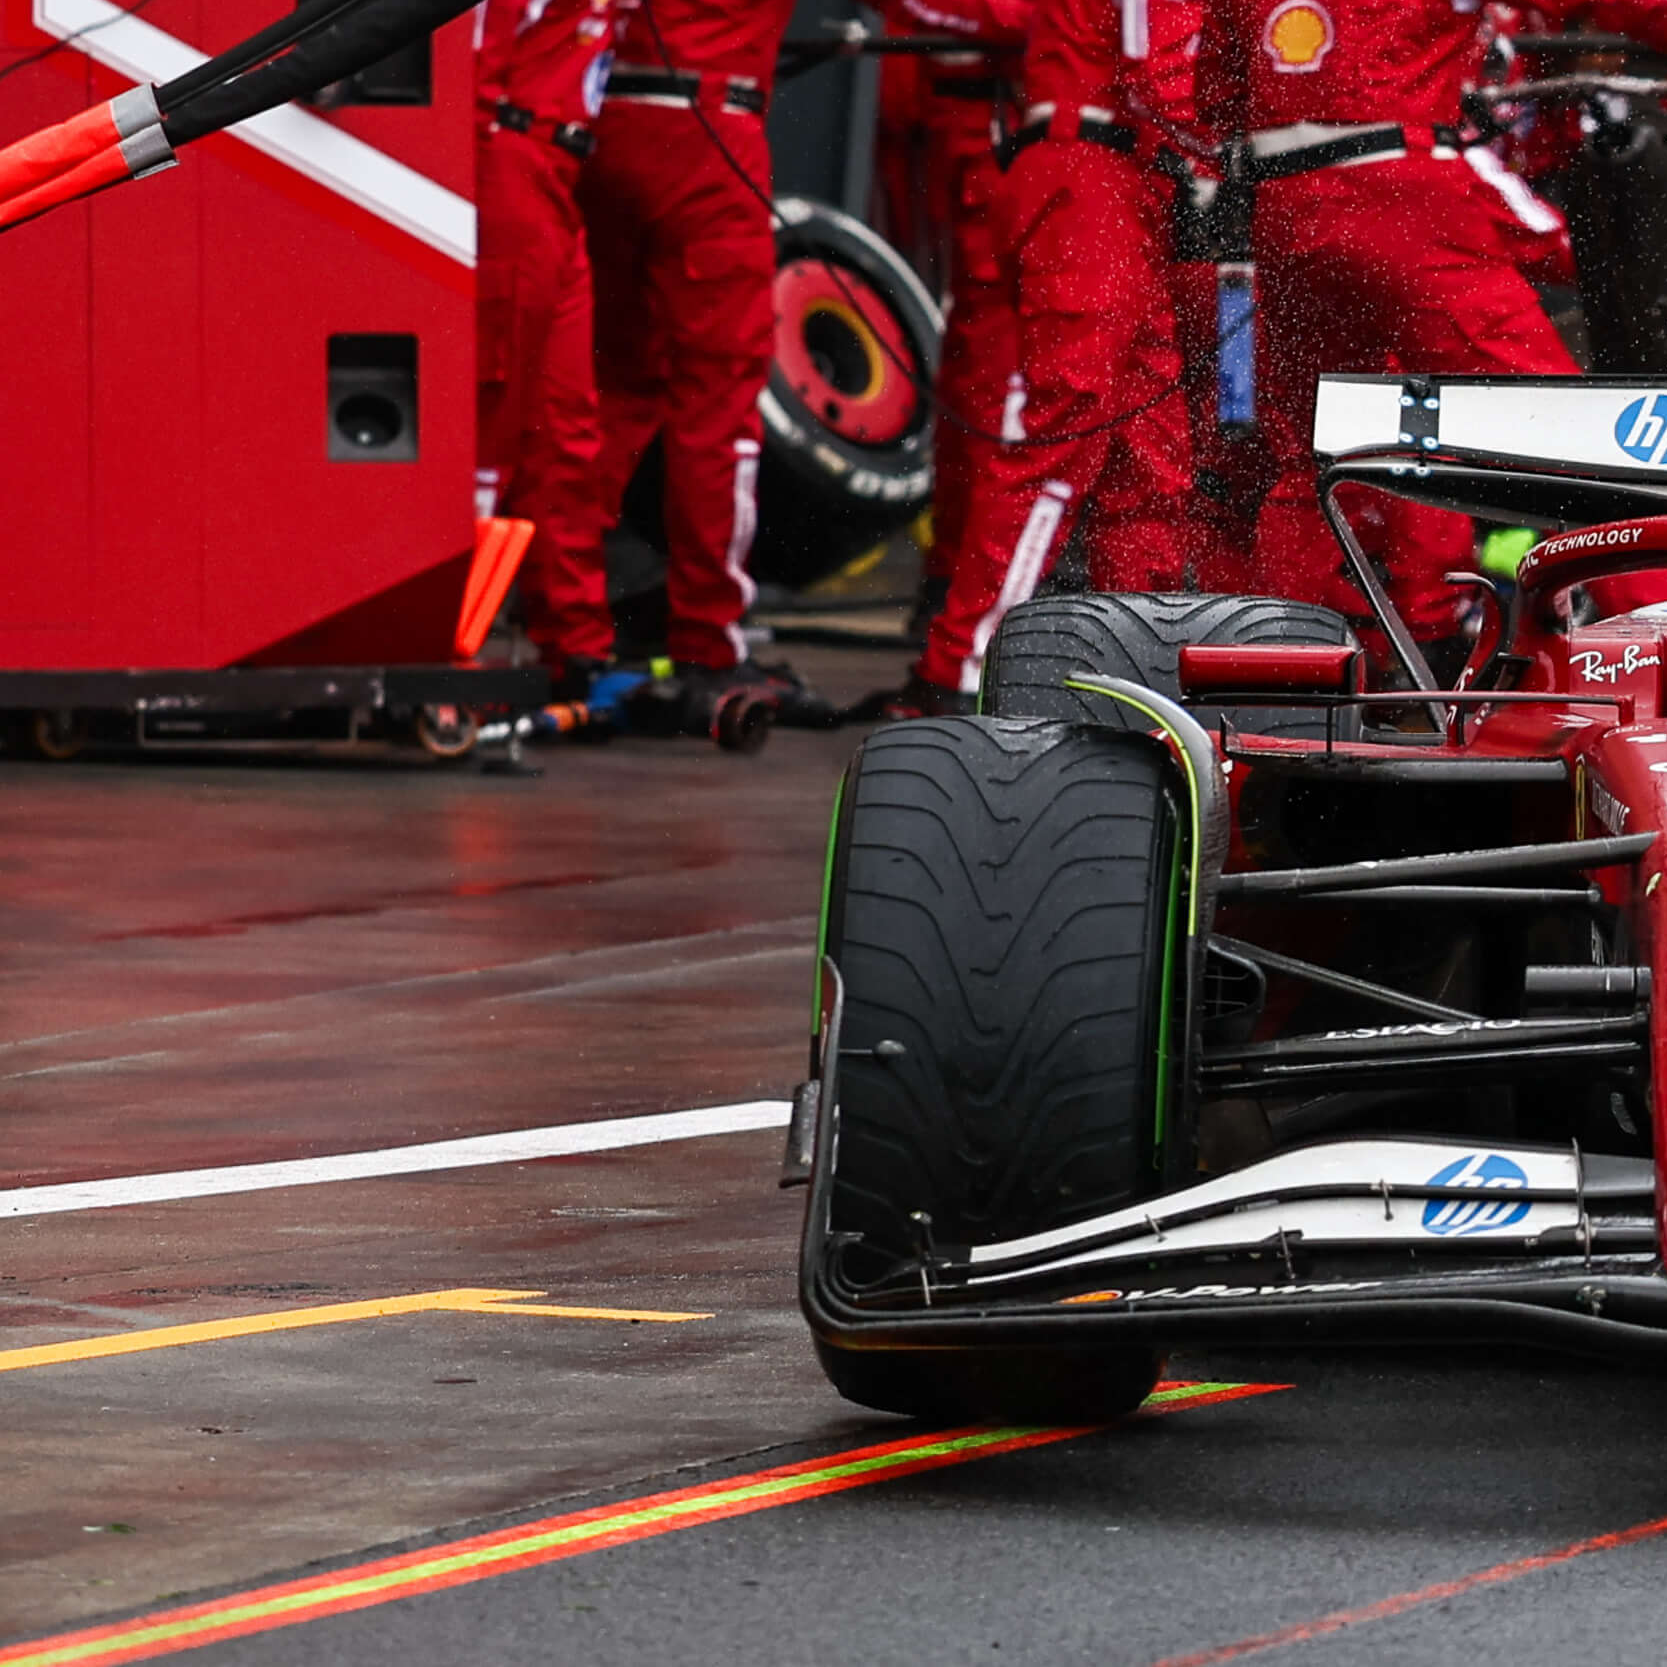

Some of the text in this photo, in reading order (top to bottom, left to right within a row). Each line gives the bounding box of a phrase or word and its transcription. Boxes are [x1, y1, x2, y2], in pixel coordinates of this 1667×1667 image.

[1543, 527, 1643, 556] TECHNOLOGY
[1569, 645, 1661, 684] Ray-Ban
[1430, 1155, 1527, 1236] hp
